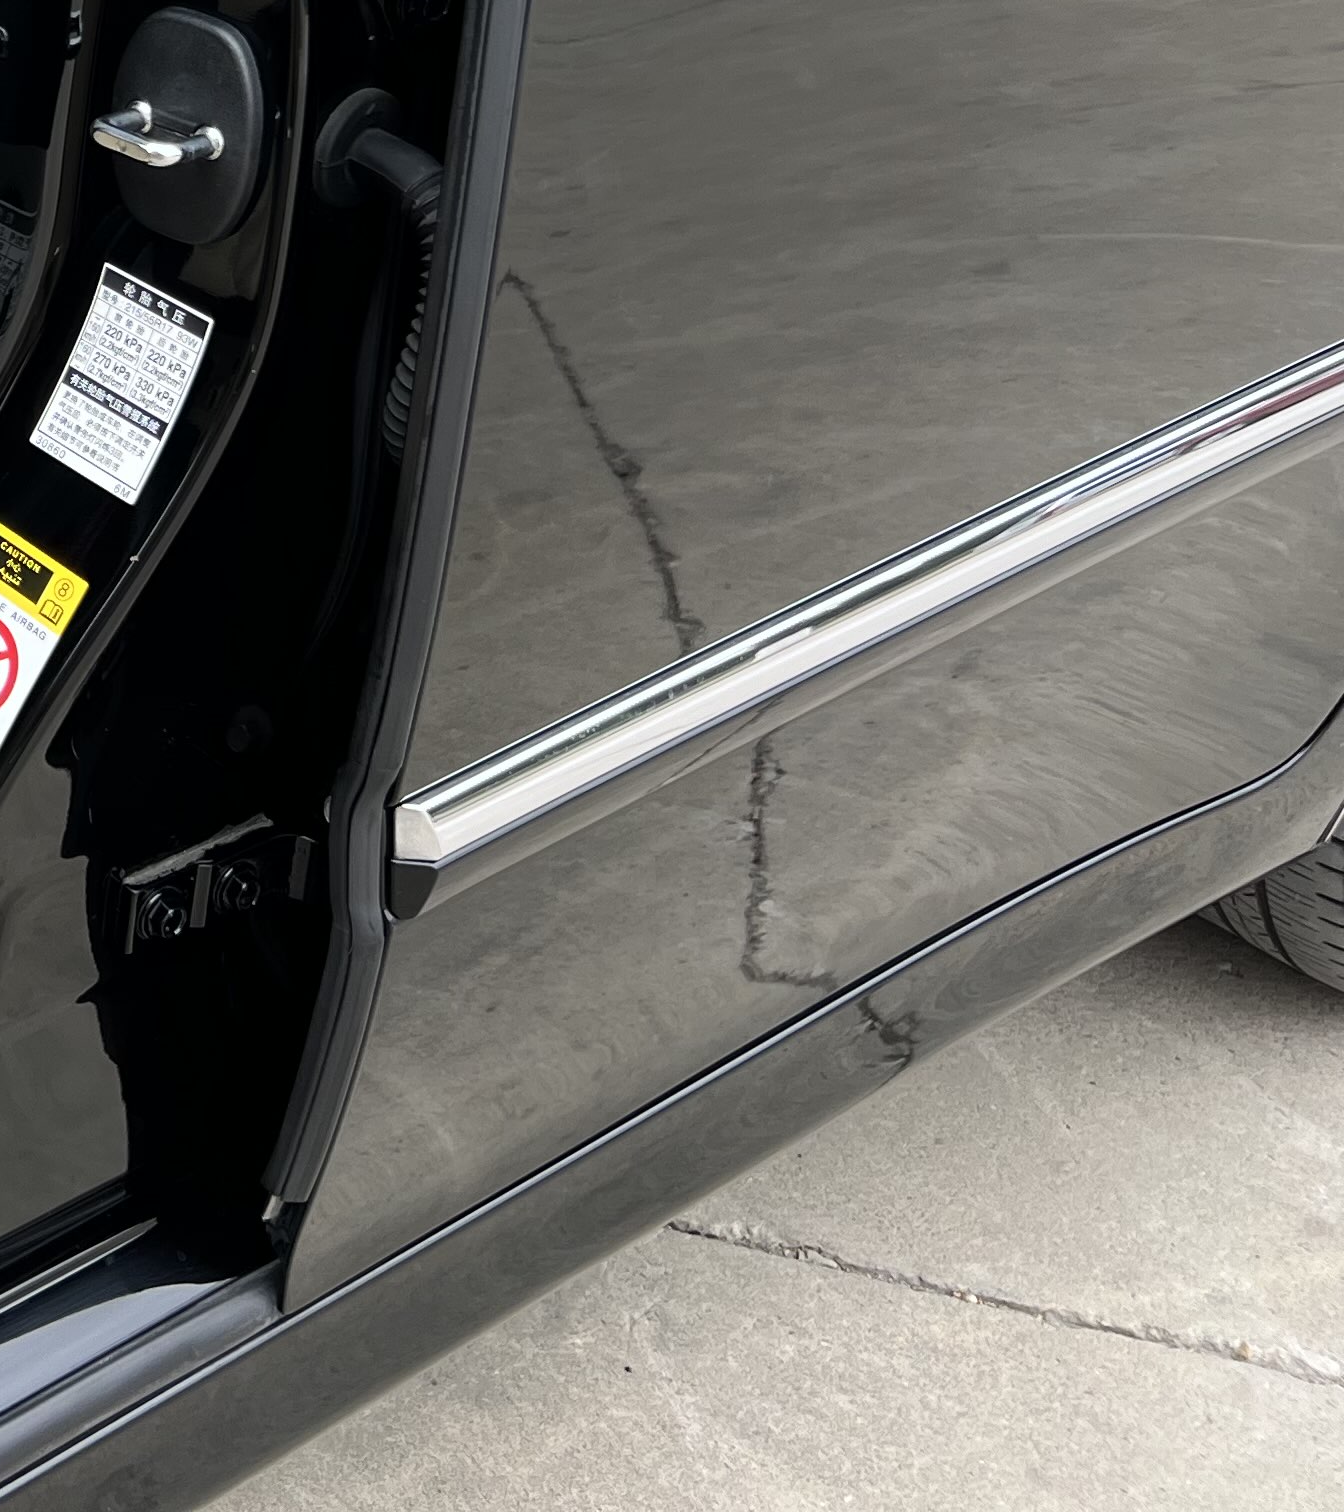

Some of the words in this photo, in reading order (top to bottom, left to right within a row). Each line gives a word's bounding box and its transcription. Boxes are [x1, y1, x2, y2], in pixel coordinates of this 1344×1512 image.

[121, 281, 188, 325] 轮胎气压
[124, 302, 173, 334] 215/55R17
[104, 324, 122, 341] 220
[123, 334, 143, 352] kPa
[92, 351, 111, 368] 270
[112, 362, 131, 380] kPa
[146, 348, 166, 366] 220
[166, 359, 187, 378] kPa
[135, 376, 154, 394] 330
[154, 388, 175, 406] kPa
[0, 540, 40, 573] CAUTION
[10, 611, 46, 640] AIRBAG
